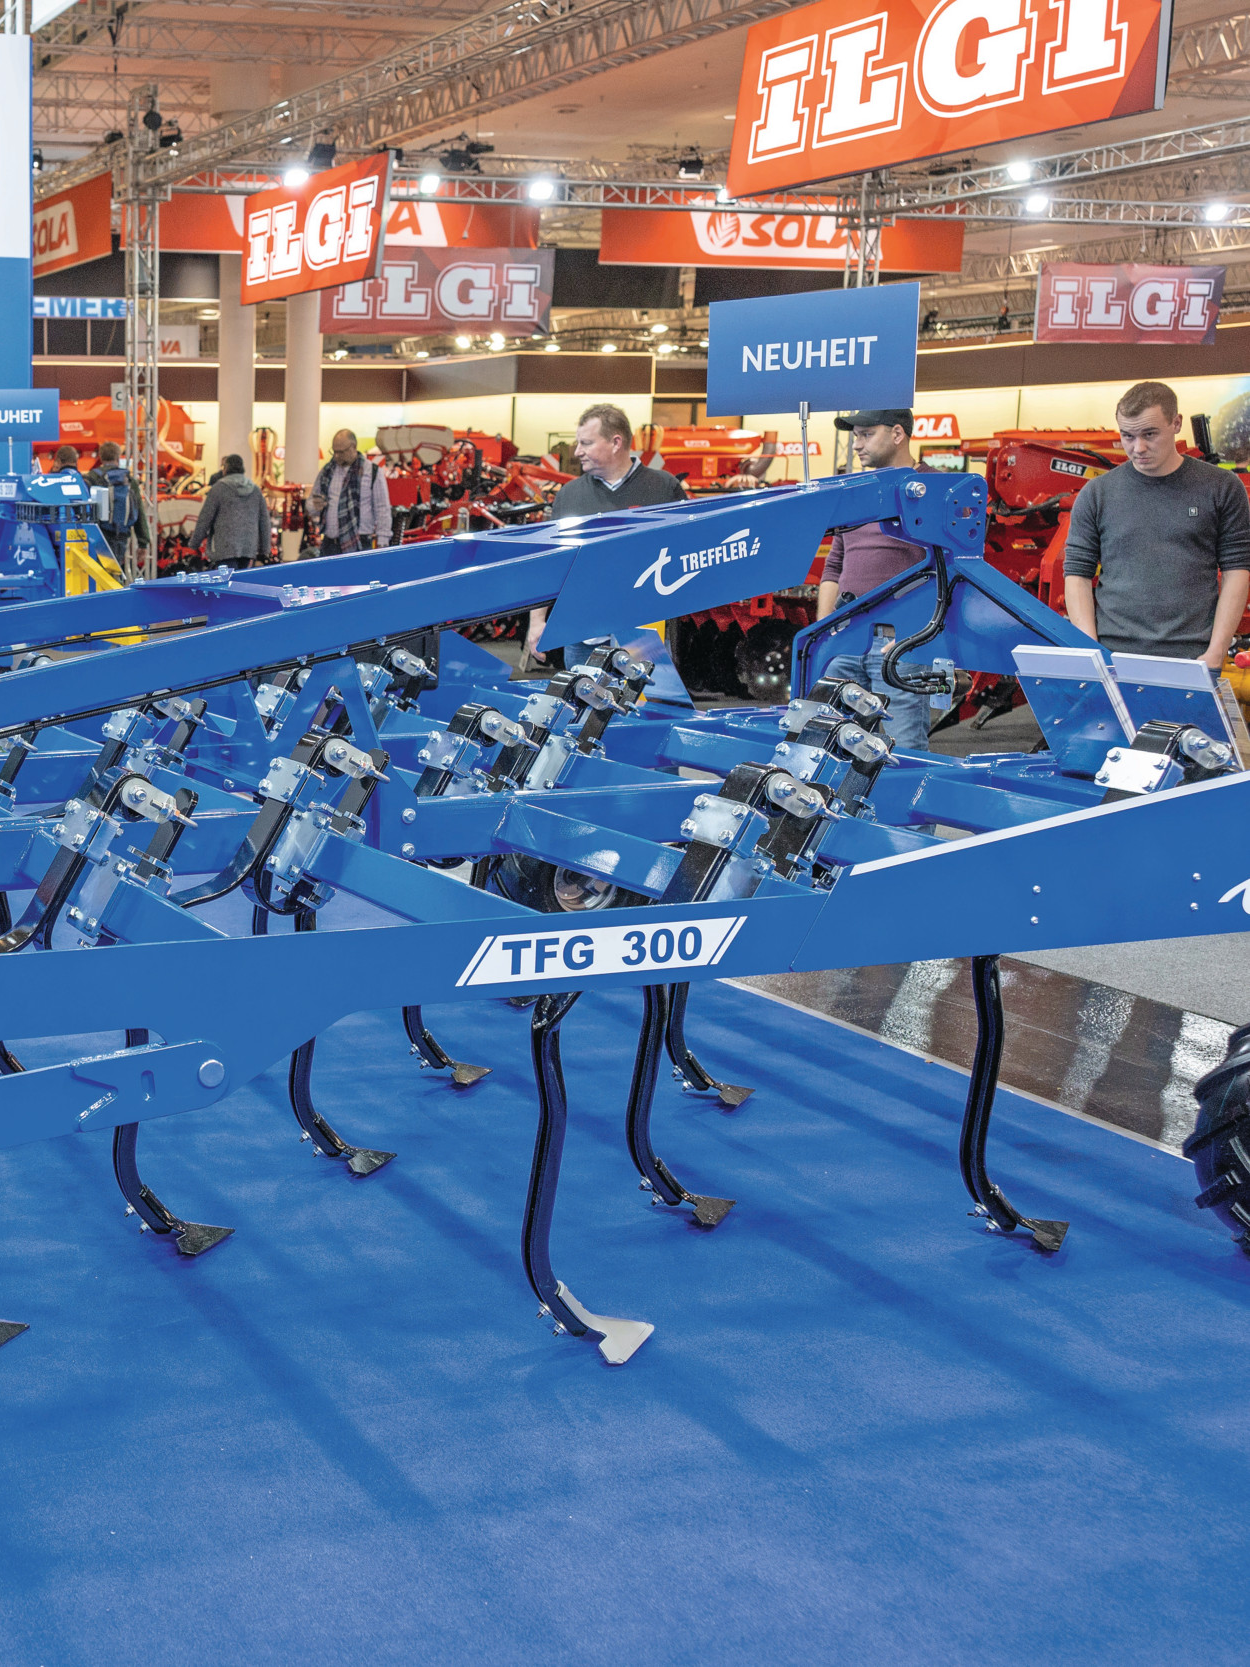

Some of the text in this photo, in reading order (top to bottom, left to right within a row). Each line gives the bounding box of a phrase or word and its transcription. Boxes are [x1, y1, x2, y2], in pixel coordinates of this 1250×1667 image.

[741, 335, 878, 373] NEUHEIT
[912, 416, 953, 438] OLA
[680, 540, 748, 573] TREFFLER
[502, 926, 703, 976] TFG 300
